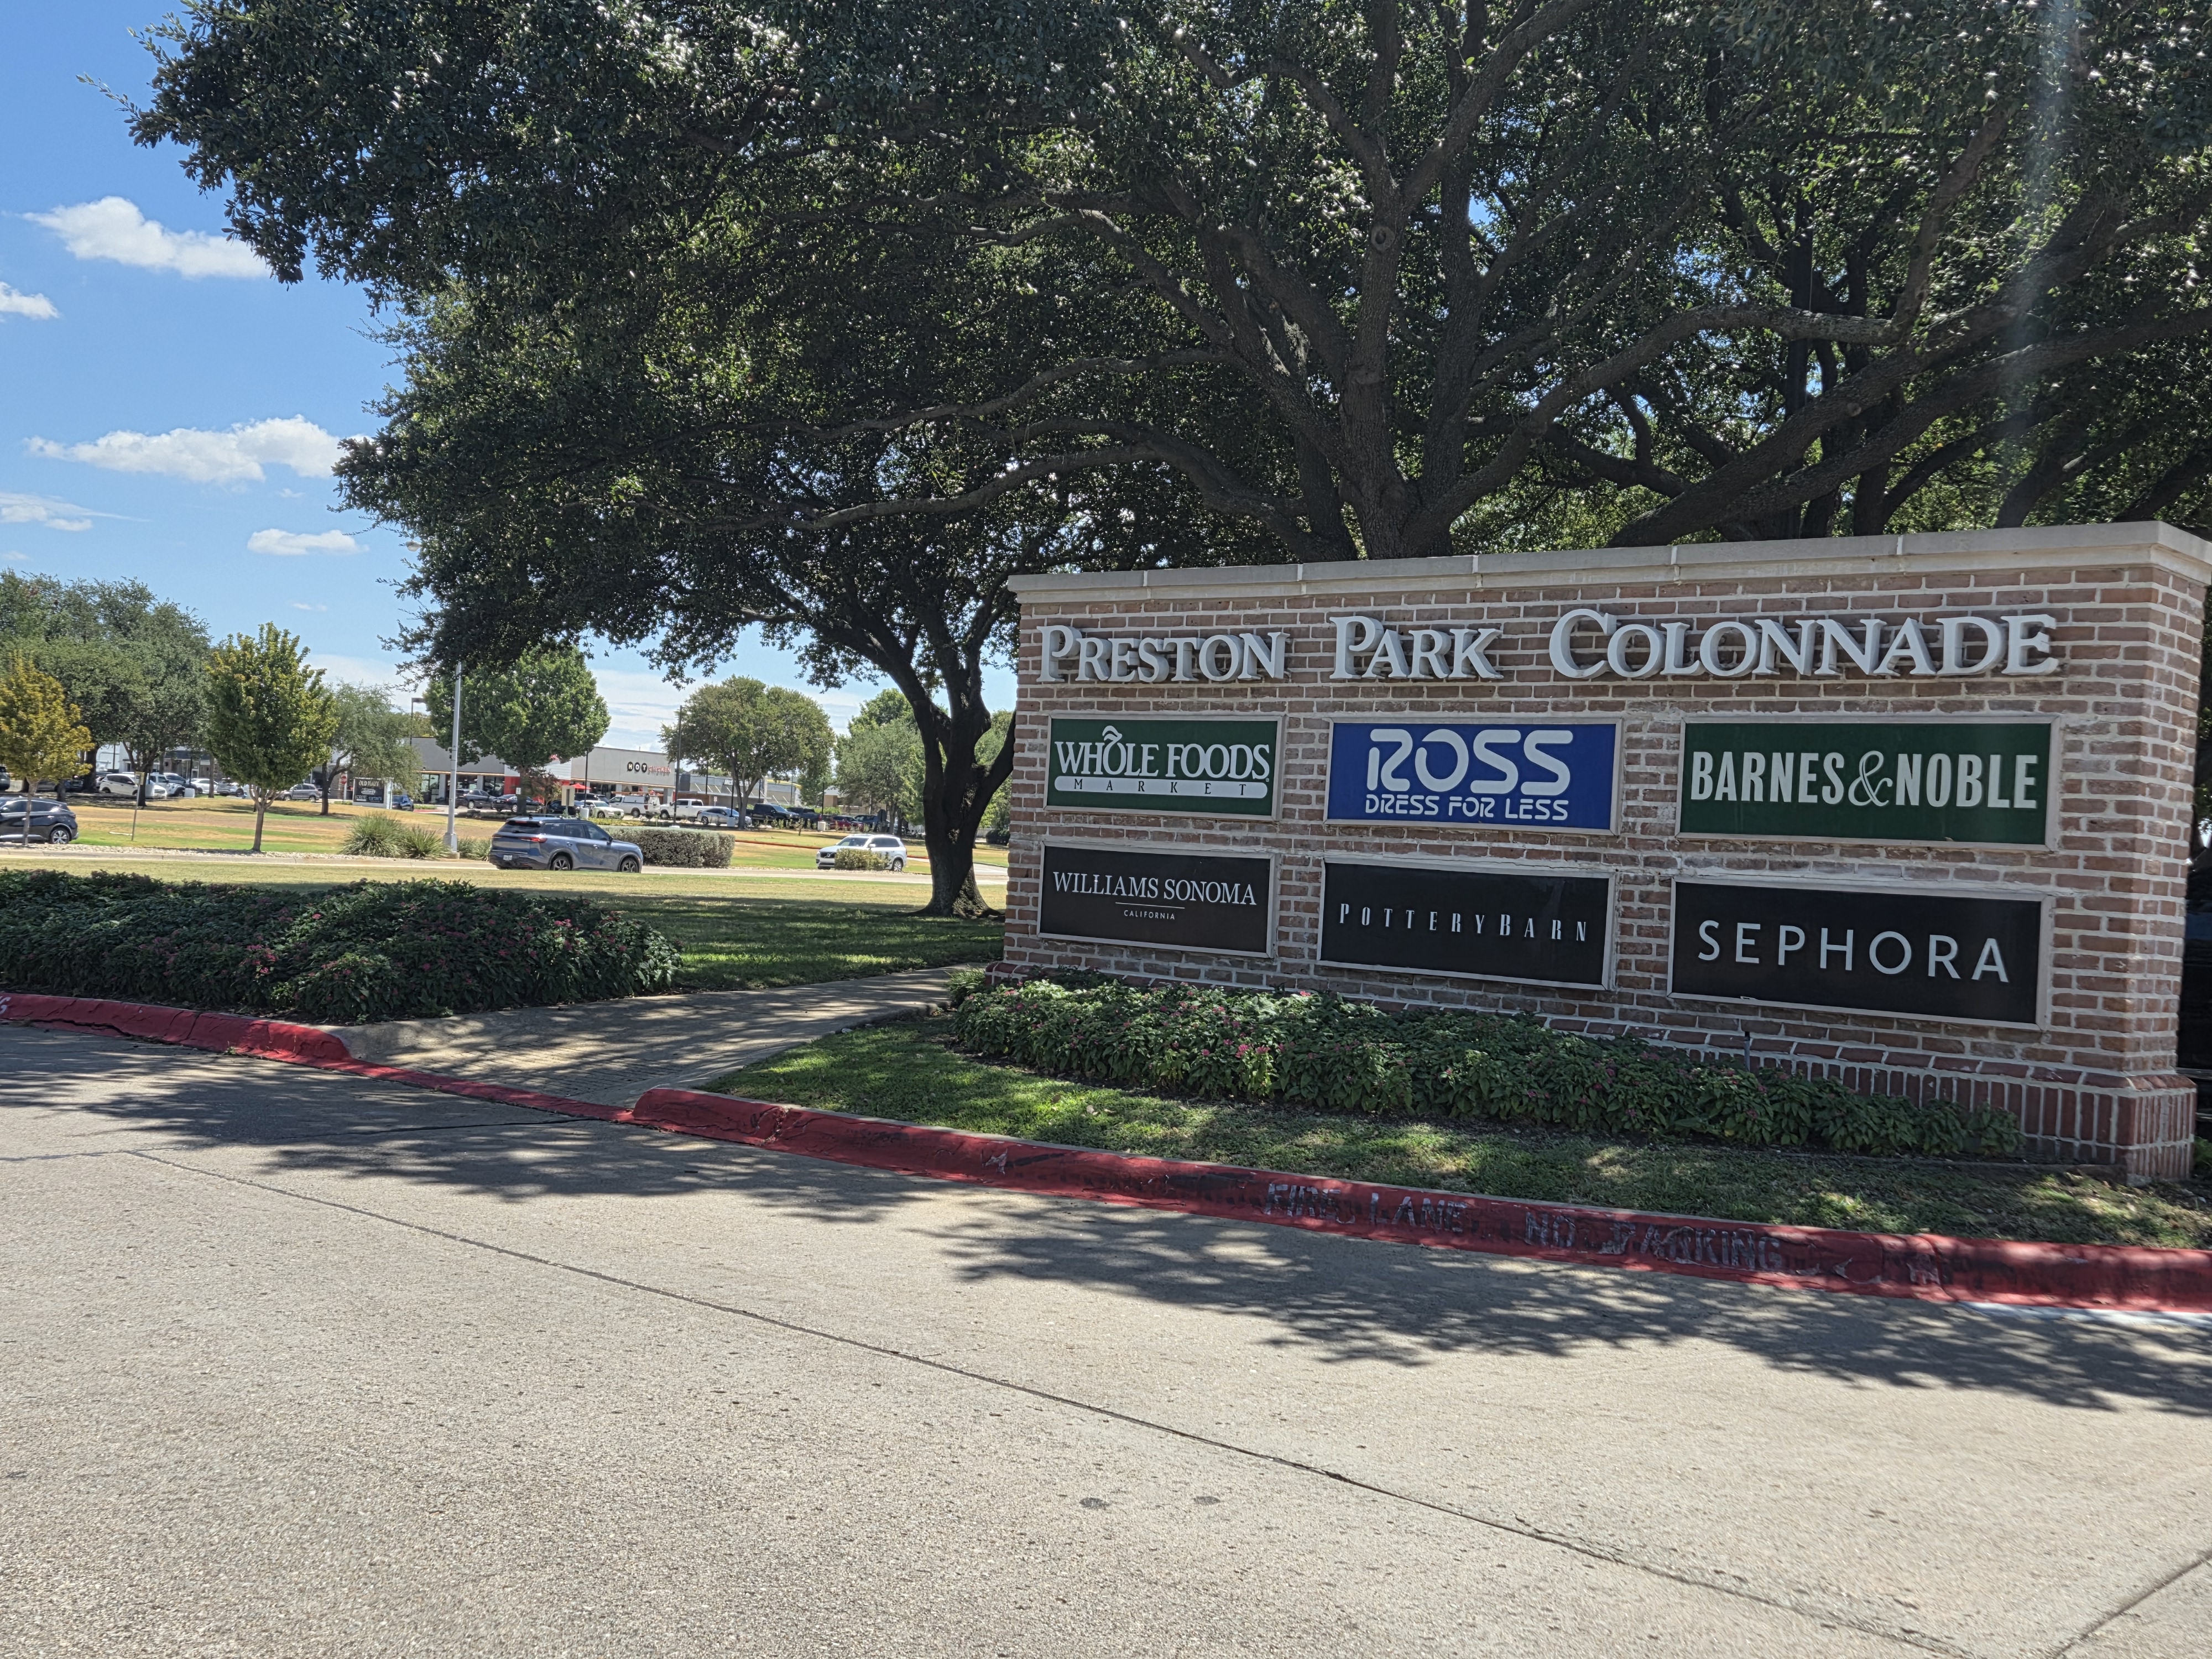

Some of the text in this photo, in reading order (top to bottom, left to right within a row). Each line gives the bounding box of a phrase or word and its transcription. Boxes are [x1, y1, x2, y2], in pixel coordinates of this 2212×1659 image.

[628, 763, 647, 771] HOT
[1055, 726, 1270, 780] WHOLE FOODS
[1366, 728, 1574, 796] ROSS
[1074, 778, 1246, 796] MARKET
[1365, 794, 1569, 821] DRESS FOR LESS
[1052, 872, 1257, 905] WILLIAMS SONOMA
[1123, 909, 1176, 921] CALIFORNIA
[1697, 920, 2010, 983] SEPHORA
[1368, 1192, 1468, 1233] LANE
